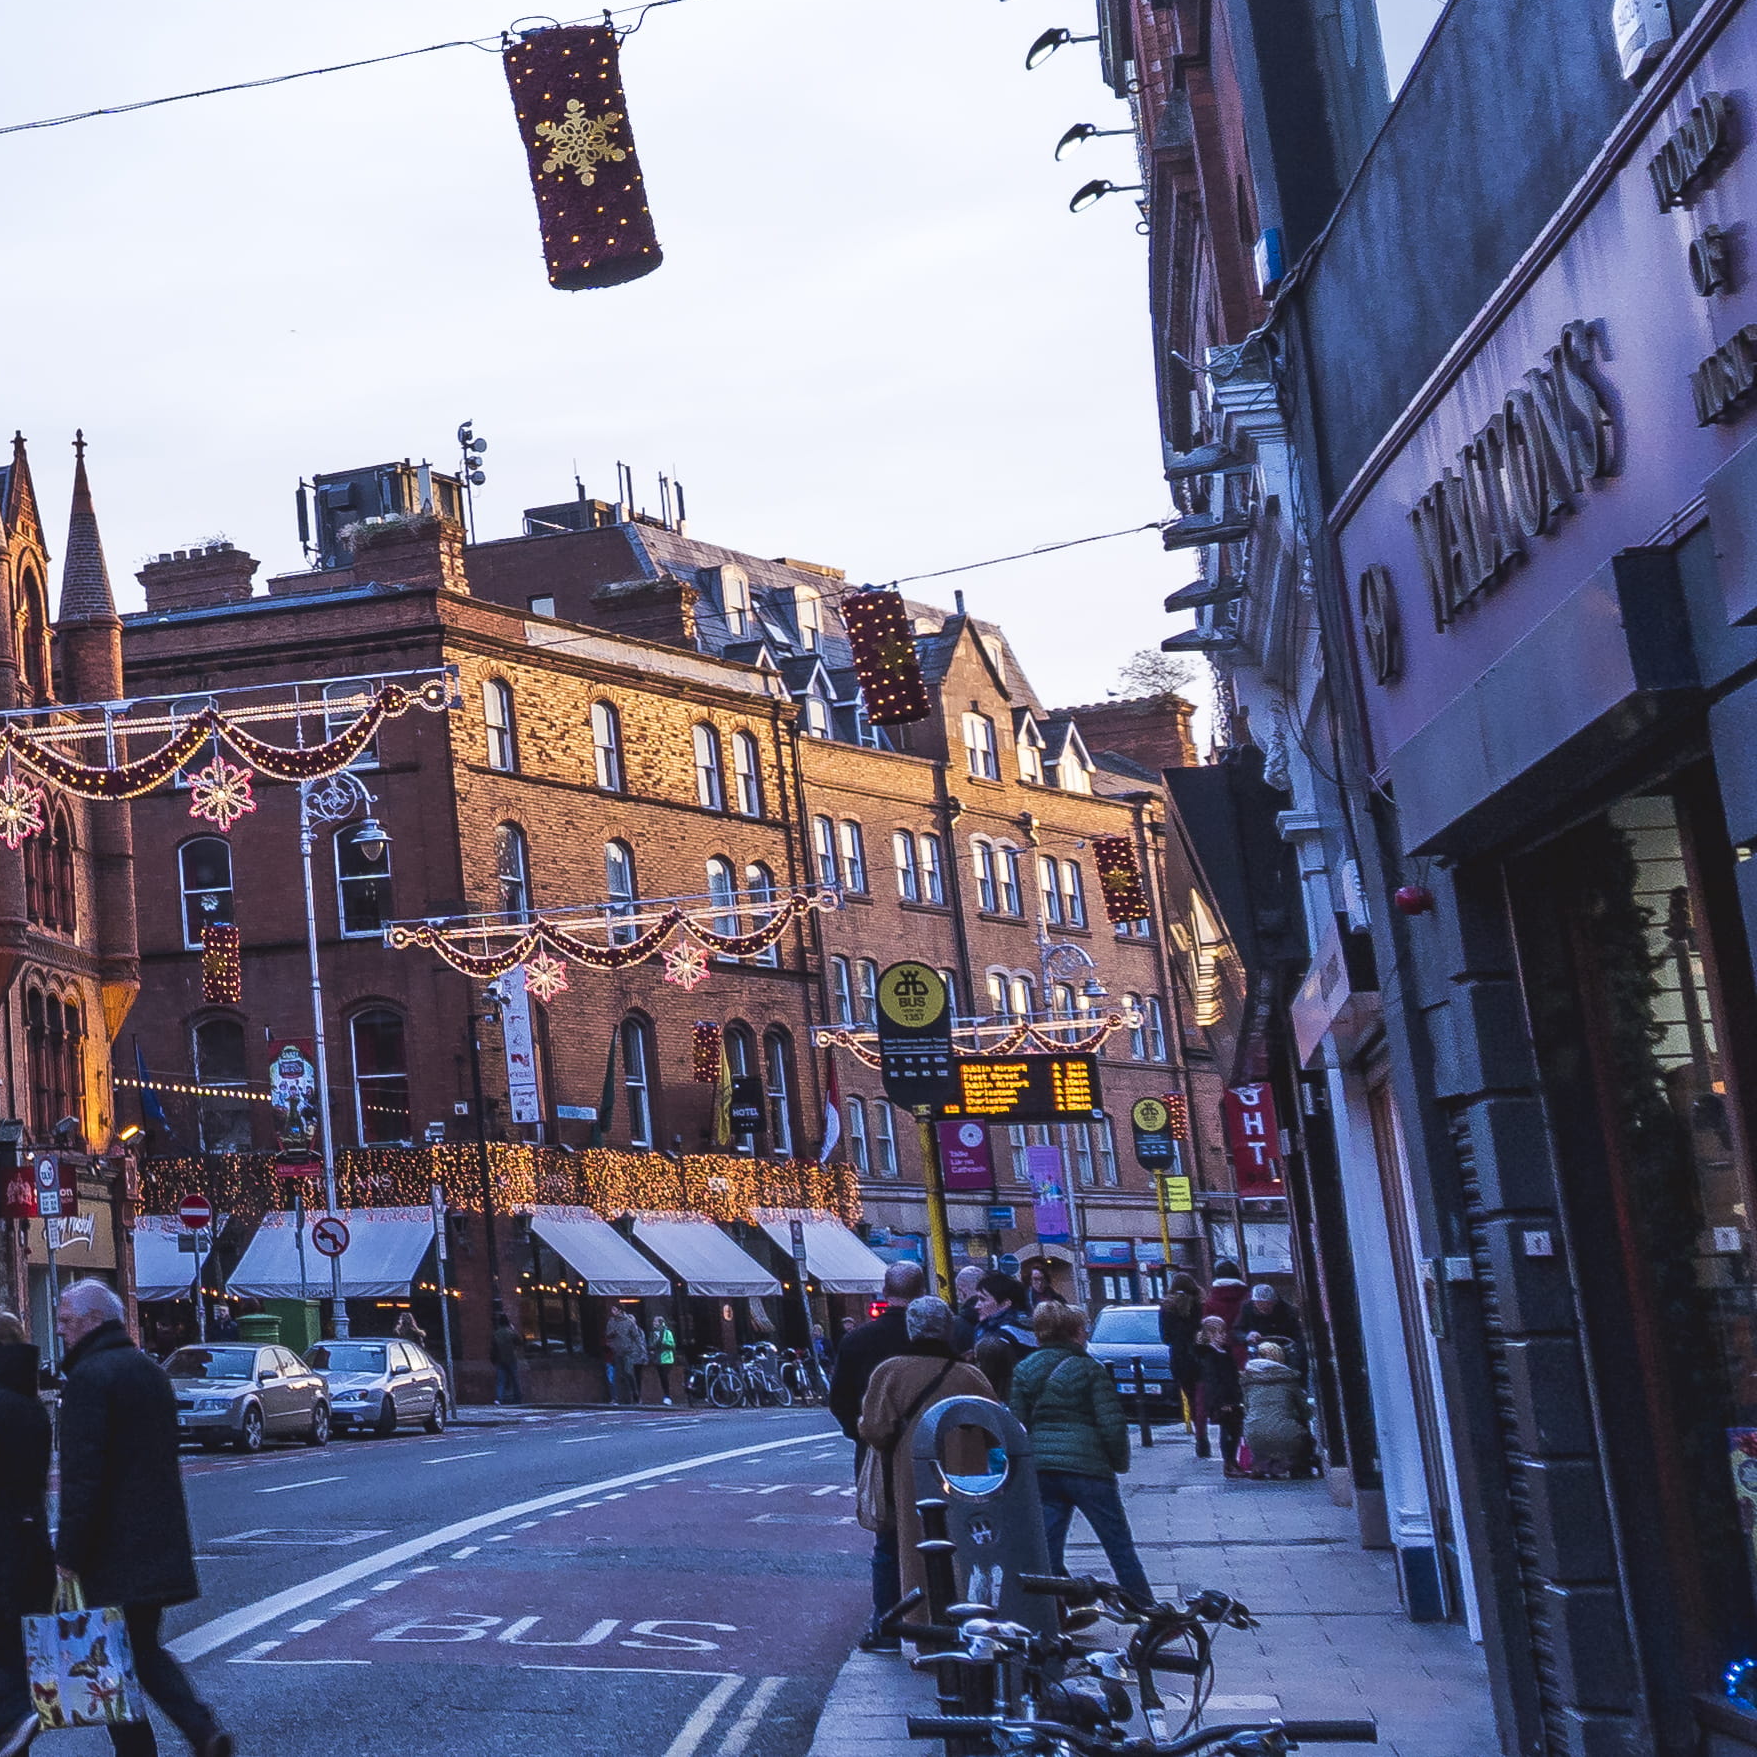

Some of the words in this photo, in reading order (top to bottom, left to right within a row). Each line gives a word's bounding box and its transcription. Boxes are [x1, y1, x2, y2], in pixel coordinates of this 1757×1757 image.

[1689, 224, 1725, 297] OF
[1406, 320, 1611, 634] WALTONS
[898, 997, 926, 1007] BUS
[962, 1065, 992, 1073] Dublin
[993, 1063, 1028, 1072] Airport
[990, 1072, 1019, 1080] Street
[964, 1081, 993, 1089] Dublin
[995, 1079, 1030, 1088] Airport
[966, 1097, 1019, 1105] Charlestown
[733, 1108, 758, 1117] HOTEL
[371, 1612, 739, 1651] BUS
